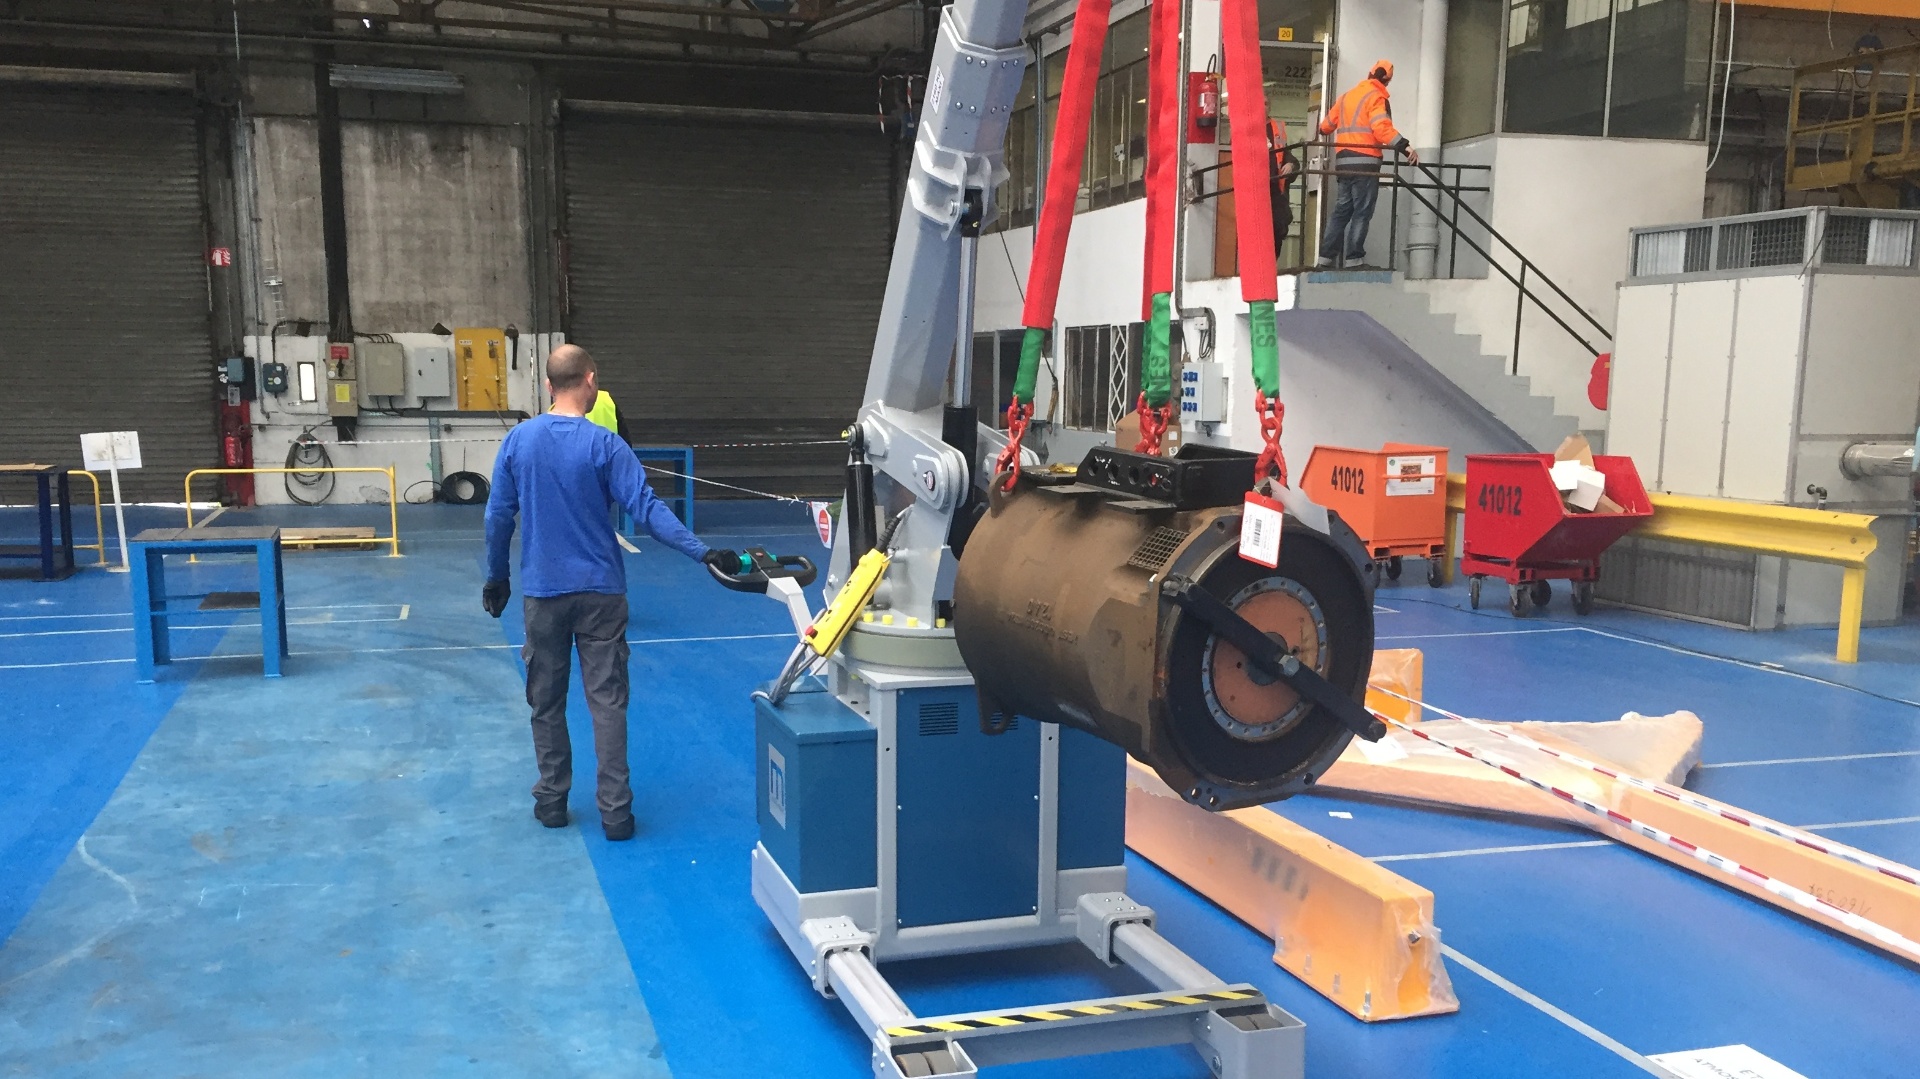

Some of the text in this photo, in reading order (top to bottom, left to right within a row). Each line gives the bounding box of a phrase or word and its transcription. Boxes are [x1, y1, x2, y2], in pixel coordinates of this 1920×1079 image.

[1281, 30, 1291, 38] 20
[1331, 465, 1365, 494] 41012
[1478, 483, 1523, 516] 41012
